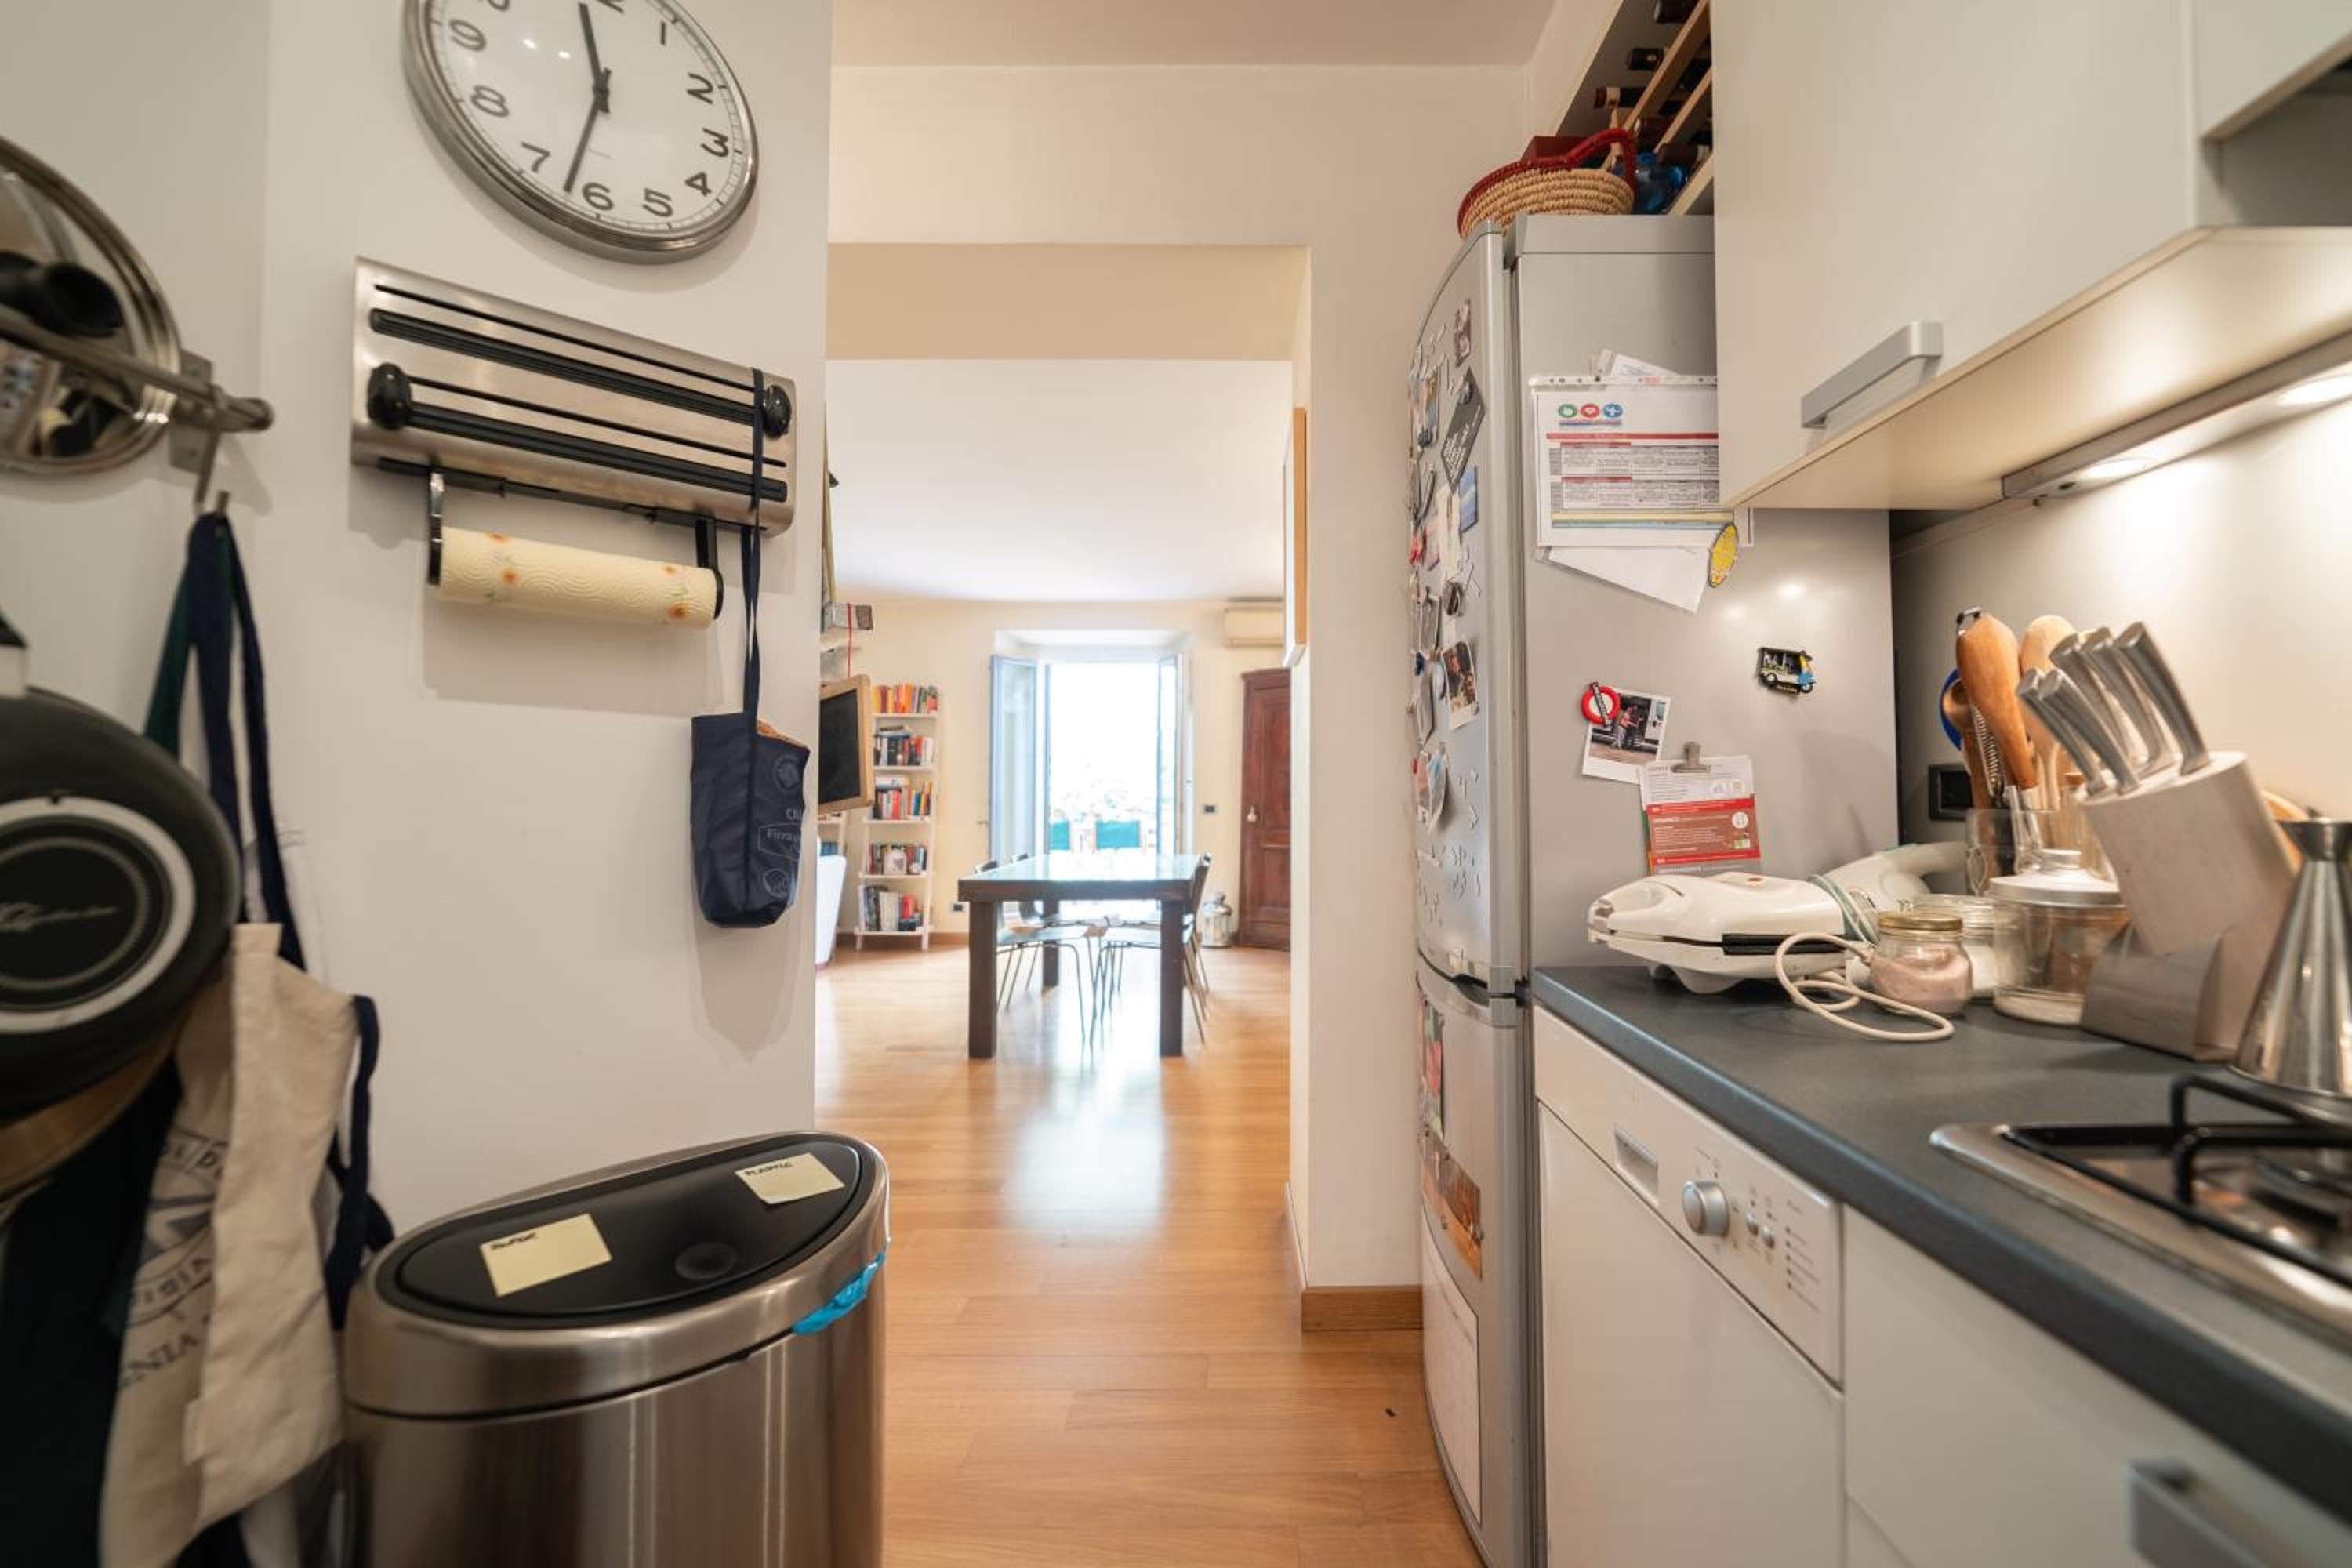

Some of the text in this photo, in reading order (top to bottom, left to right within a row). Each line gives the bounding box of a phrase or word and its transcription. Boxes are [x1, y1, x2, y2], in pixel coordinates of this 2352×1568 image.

[448, 19, 487, 52] 9
[659, 21, 666, 45] 1
[470, 85, 510, 118] 8
[686, 73, 714, 105] 2
[521, 142, 552, 172] 7
[700, 128, 729, 158] 3
[582, 182, 615, 212] 6
[684, 172, 713, 196] 4
[641, 187, 673, 218] 5
